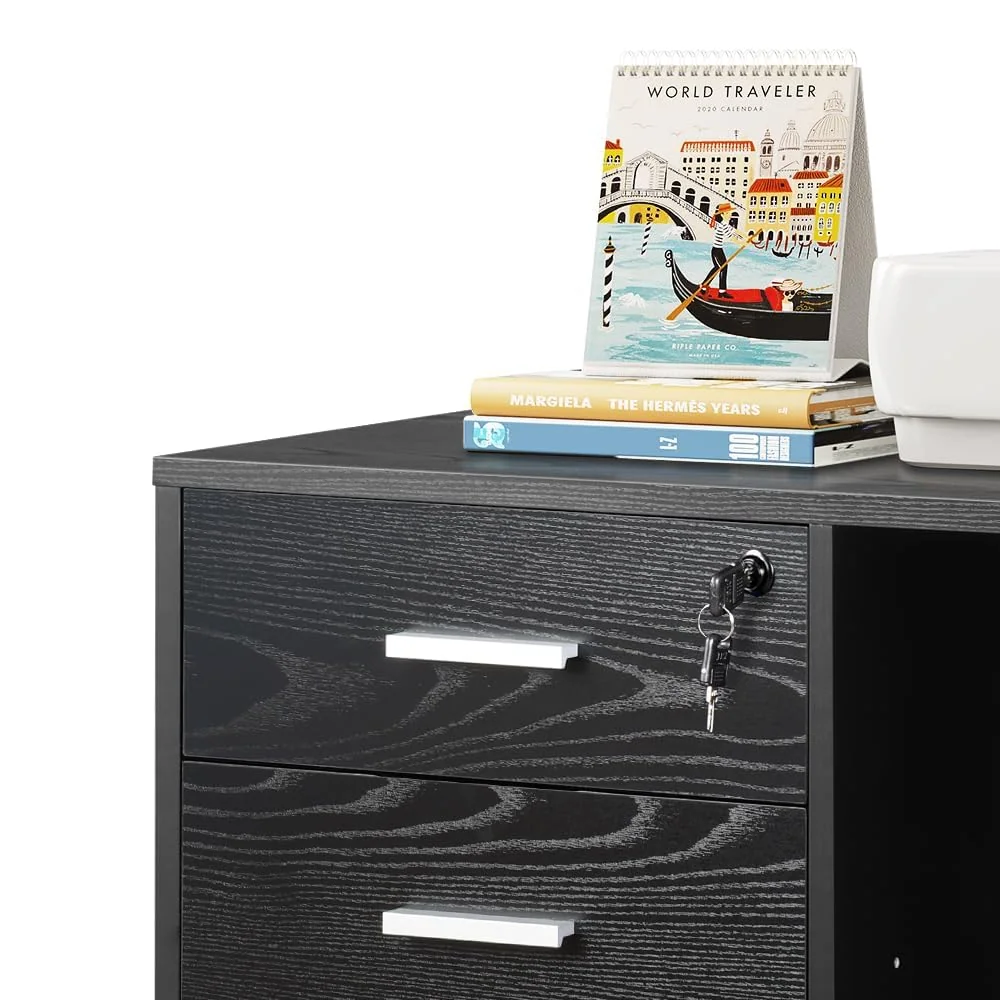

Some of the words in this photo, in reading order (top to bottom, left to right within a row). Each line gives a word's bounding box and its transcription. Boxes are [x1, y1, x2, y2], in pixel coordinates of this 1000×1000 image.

[647, 85, 714, 98] WORLD
[724, 84, 817, 98] TRAVELER
[510, 394, 592, 409] MARGIELA
[609, 399, 638, 411] THE
[710, 402, 761, 416] YEARS
[728, 433, 759, 460] 100
